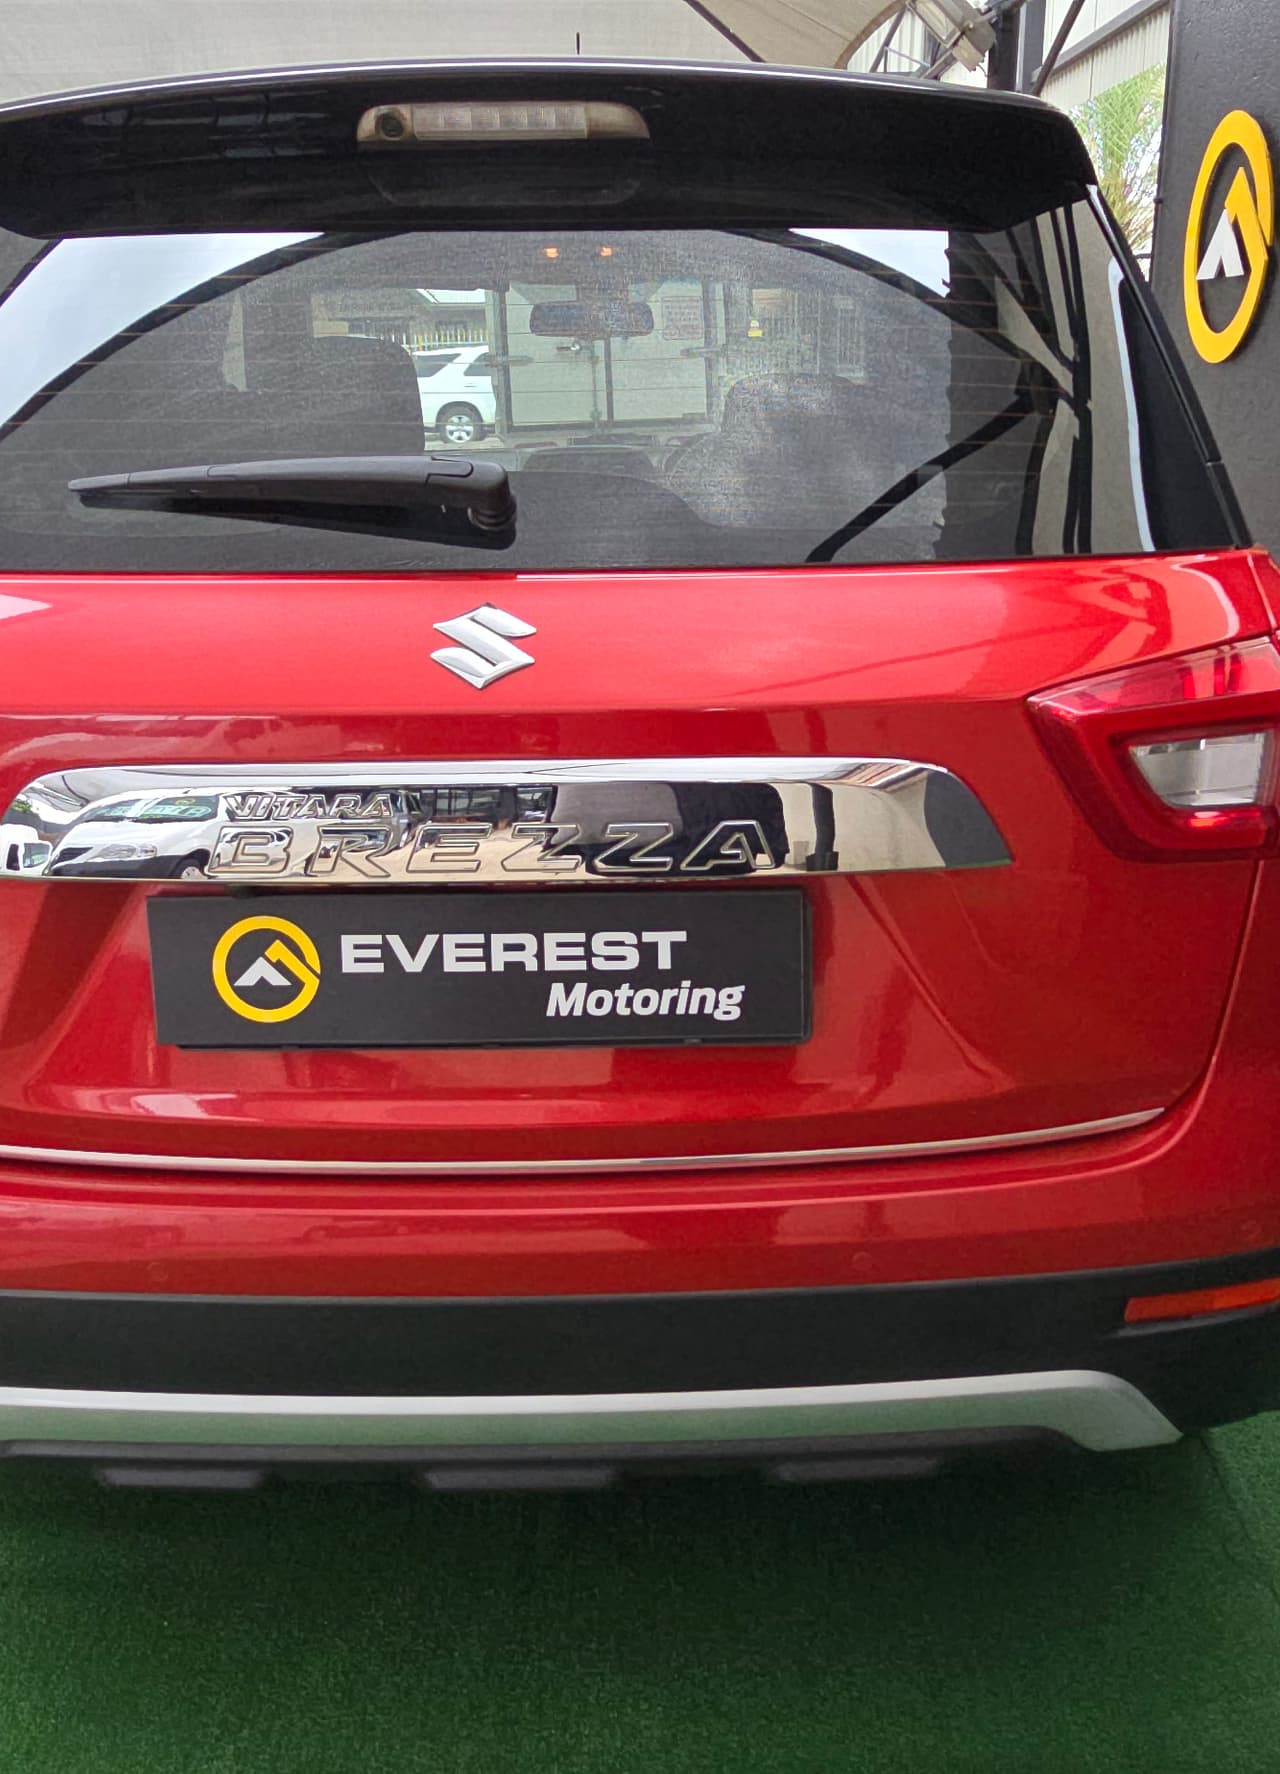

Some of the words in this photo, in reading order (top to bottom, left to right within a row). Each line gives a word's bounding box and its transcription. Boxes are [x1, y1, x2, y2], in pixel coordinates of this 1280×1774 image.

[221, 792, 394, 822] VITARA
[206, 819, 776, 879] BREZZA
[340, 930, 687, 974] EVEREST
[545, 980, 746, 1021] Motoring
